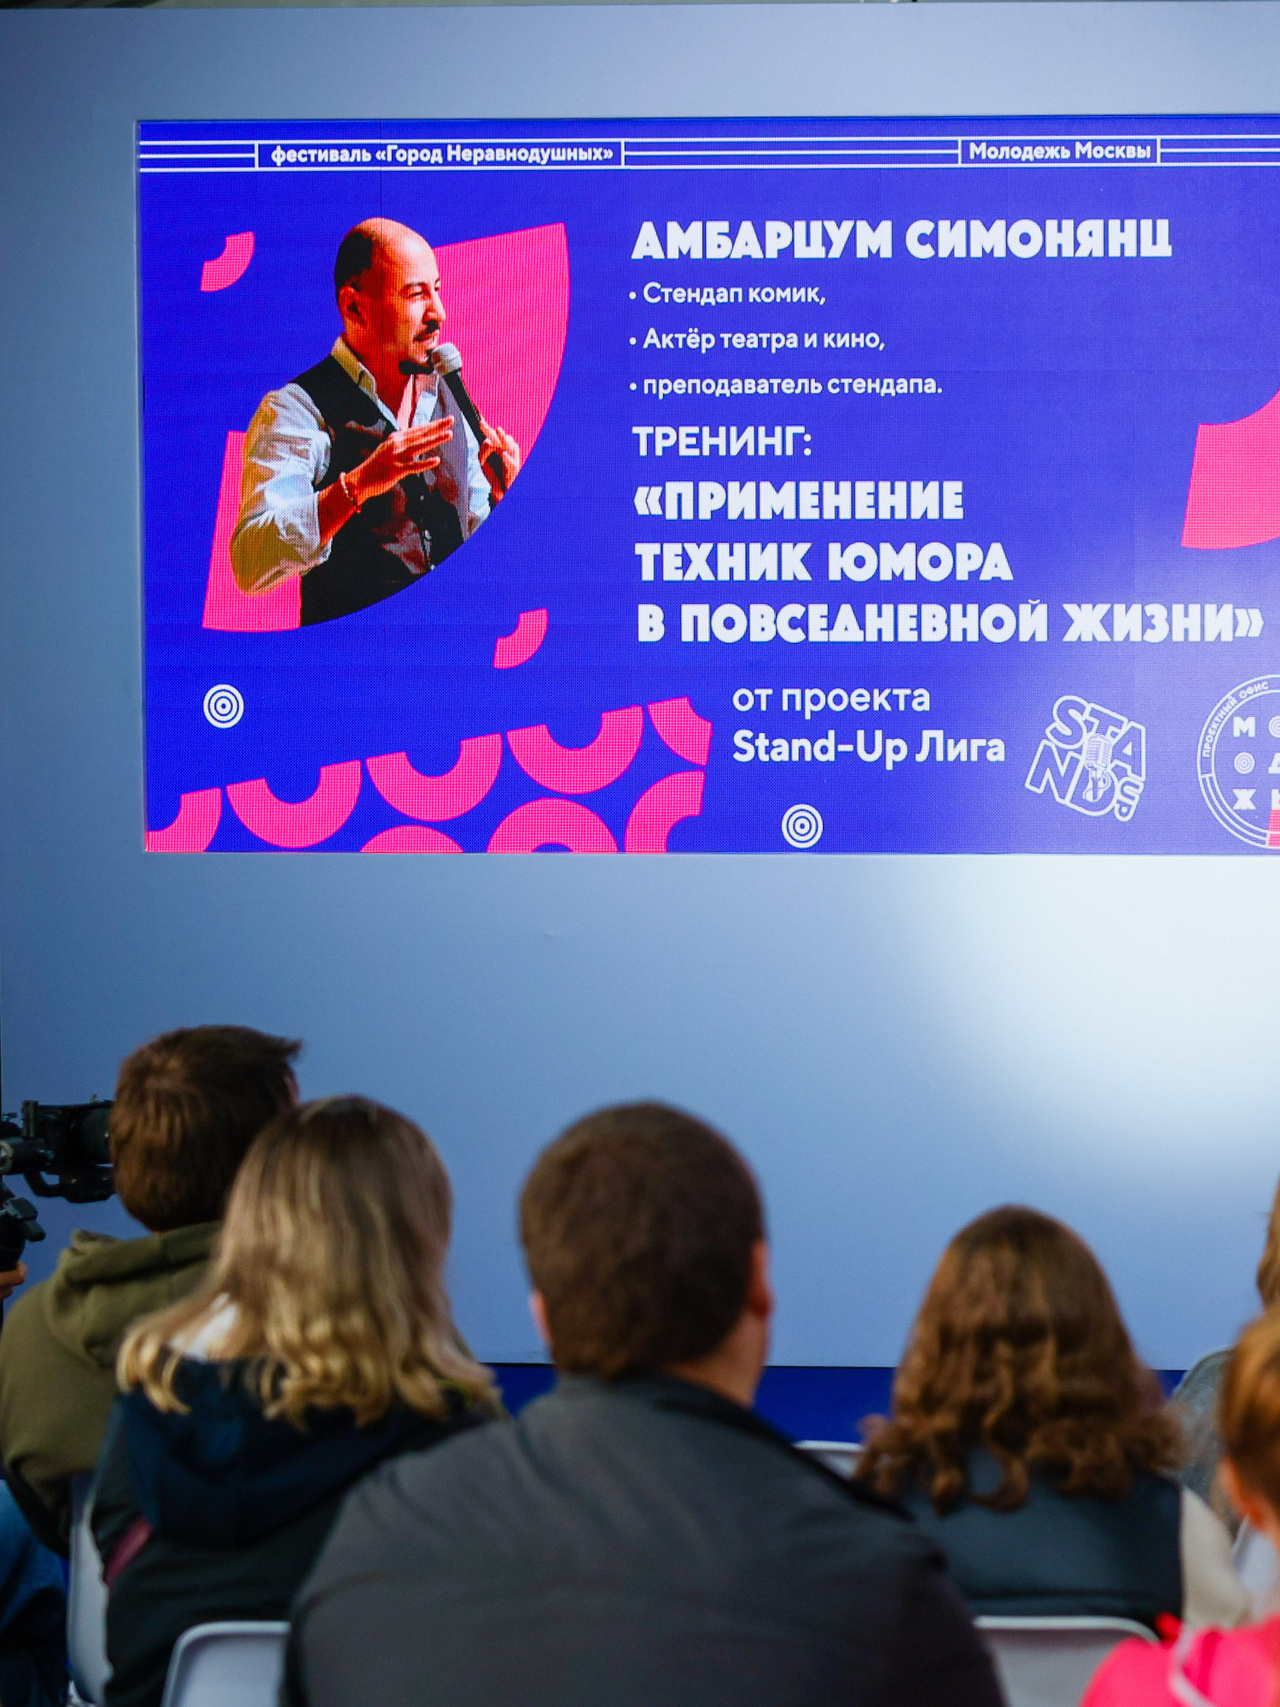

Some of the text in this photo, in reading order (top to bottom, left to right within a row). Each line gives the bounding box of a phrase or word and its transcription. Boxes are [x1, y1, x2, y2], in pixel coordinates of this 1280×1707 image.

[270, 144, 614, 166] фестиваль «Город Неравнодушных»
[969, 141, 1151, 161] Молодежь Москвы
[631, 218, 1173, 260] АМБАРЦУМ СИМОНЯНЦ
[643, 282, 826, 307] Стендап комик,
[642, 328, 886, 354] Актёр театра и кино,
[643, 378, 943, 400] преподаватель стендапа.
[632, 425, 812, 457] ТРЕНИНГ:
[633, 481, 963, 519] «ПРИМЕНЕНИЕ
[635, 541, 1014, 582] ТЕХНИК ЮМОРА
[637, 599, 1264, 642] В ПОВСЕДНЕВНОЙ ЖИЗНИ»
[732, 688, 930, 719] от проекта
[732, 730, 1006, 768] Stand-Up Лига
